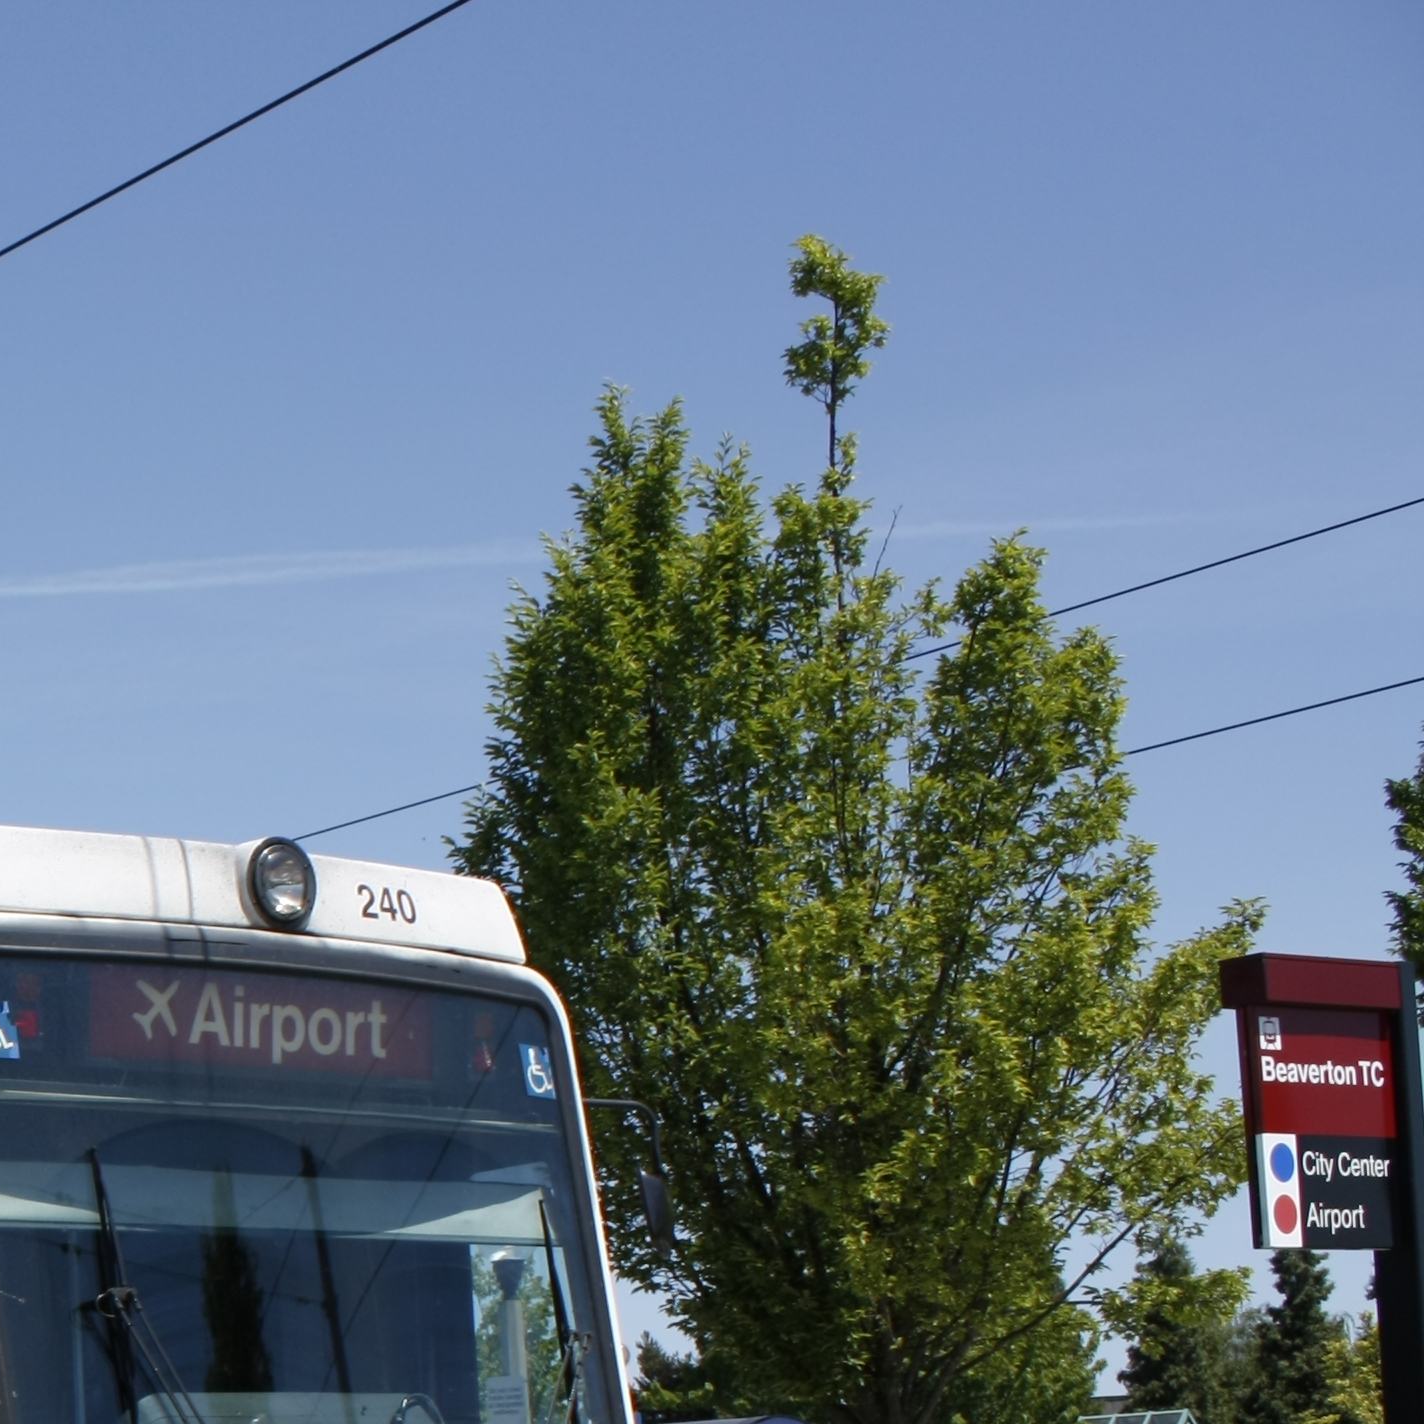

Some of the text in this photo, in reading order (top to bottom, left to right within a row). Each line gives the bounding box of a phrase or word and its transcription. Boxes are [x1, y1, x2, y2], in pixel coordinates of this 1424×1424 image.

[357, 884, 417, 924] 240
[189, 981, 389, 1065] Airport
[1260, 1055, 1385, 1088] Beaverton TC
[1301, 1151, 1391, 1183] City Center
[1306, 1202, 1366, 1235] Airport
